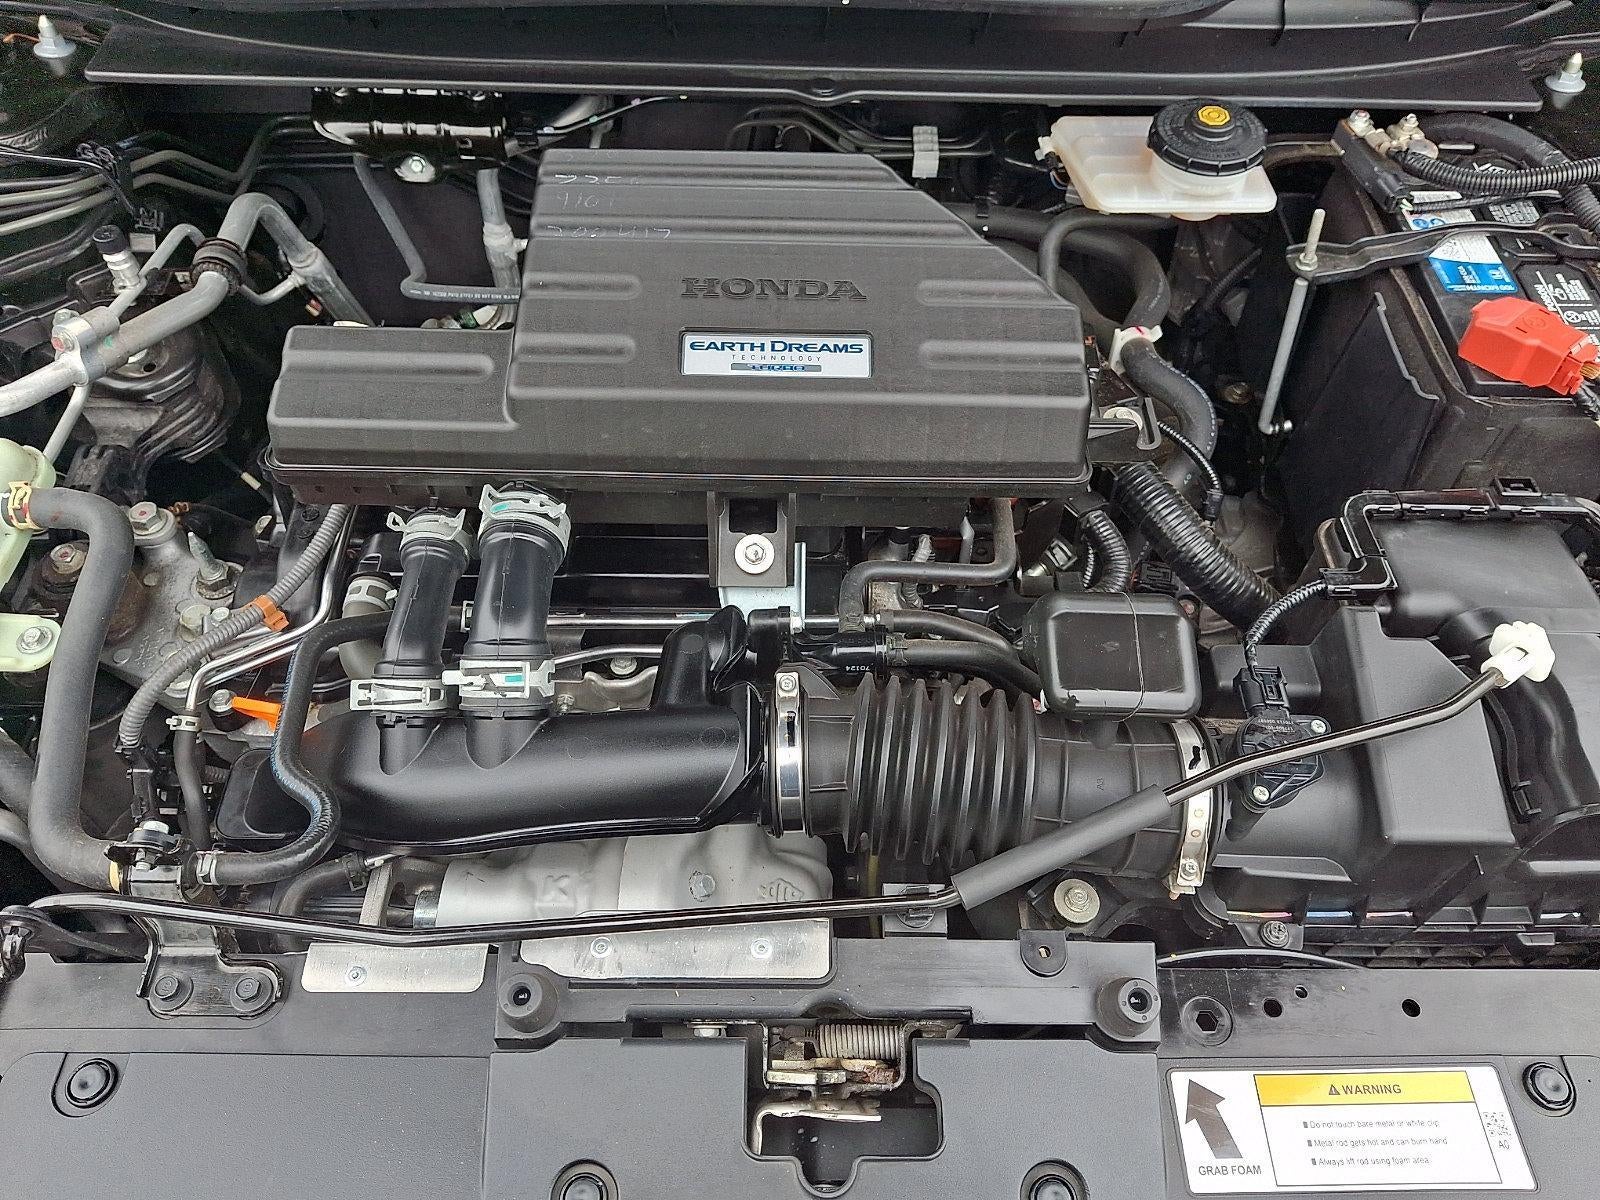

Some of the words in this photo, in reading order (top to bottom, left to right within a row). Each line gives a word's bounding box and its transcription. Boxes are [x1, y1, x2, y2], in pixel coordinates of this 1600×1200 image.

[681, 277, 867, 301] HONDA
[689, 341, 765, 352] EARTH
[771, 340, 864, 354] DREAMS
[1342, 1084, 1402, 1095] WARNING
[1358, 1120, 1373, 1128] bare
[1376, 1120, 1394, 1128] metal
[1314, 1139, 1333, 1147] Metal
[1350, 1139, 1365, 1148] gets
[1429, 1137, 1447, 1145] hand
[1319, 1158, 1344, 1167] Always
[1357, 1157, 1369, 1165] rod
[1371, 1157, 1391, 1167] using
[1392, 1156, 1410, 1165] foam
[1198, 1165, 1229, 1176] GRAB
[1232, 1165, 1262, 1175] FOAM
